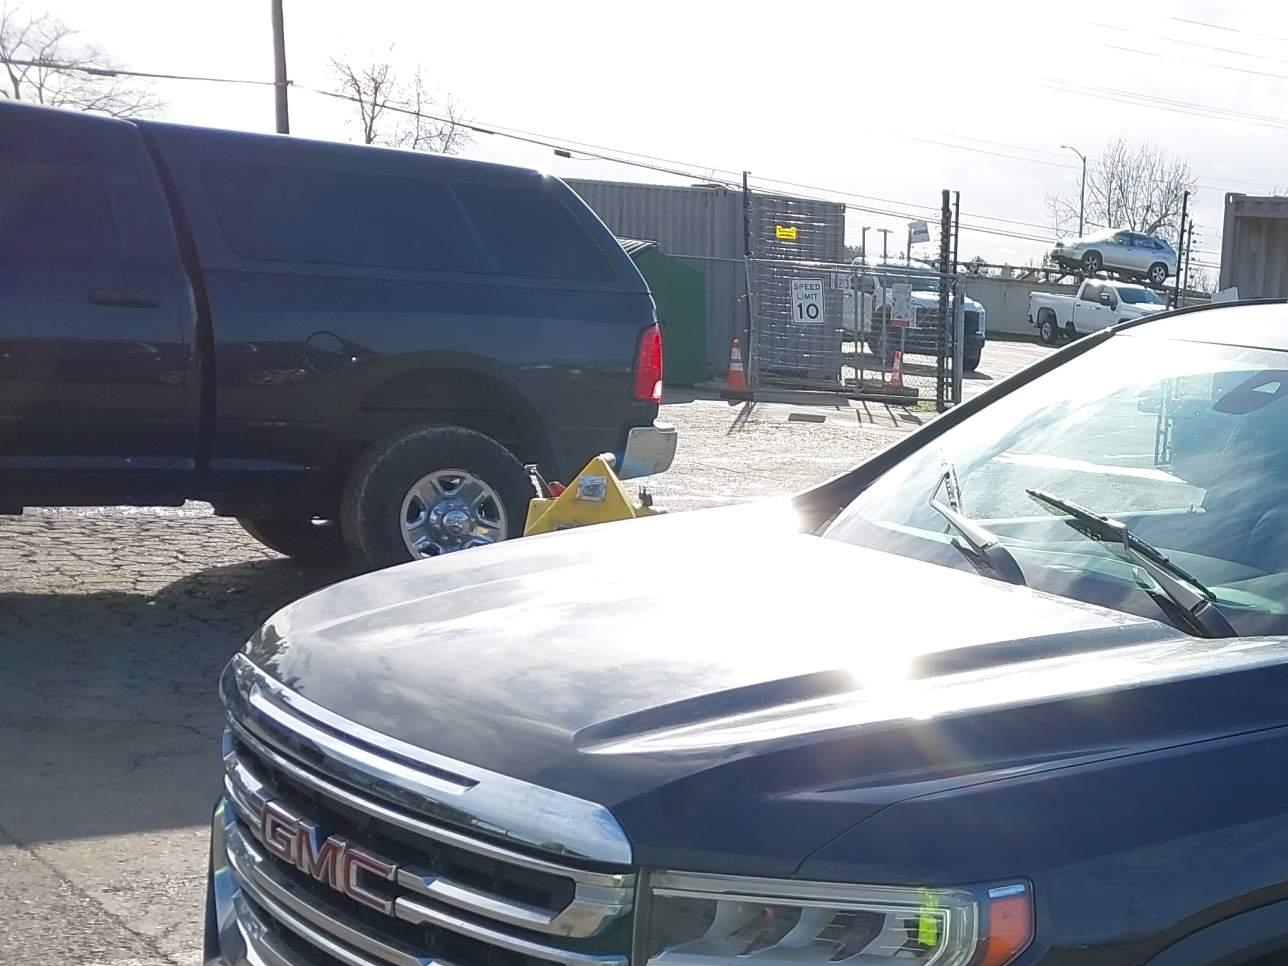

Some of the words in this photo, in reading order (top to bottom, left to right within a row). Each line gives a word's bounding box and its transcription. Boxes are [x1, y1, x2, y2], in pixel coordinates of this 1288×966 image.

[796, 292, 818, 300] LIMIT
[797, 302, 820, 320] 10
[262, 801, 398, 917] GMC
